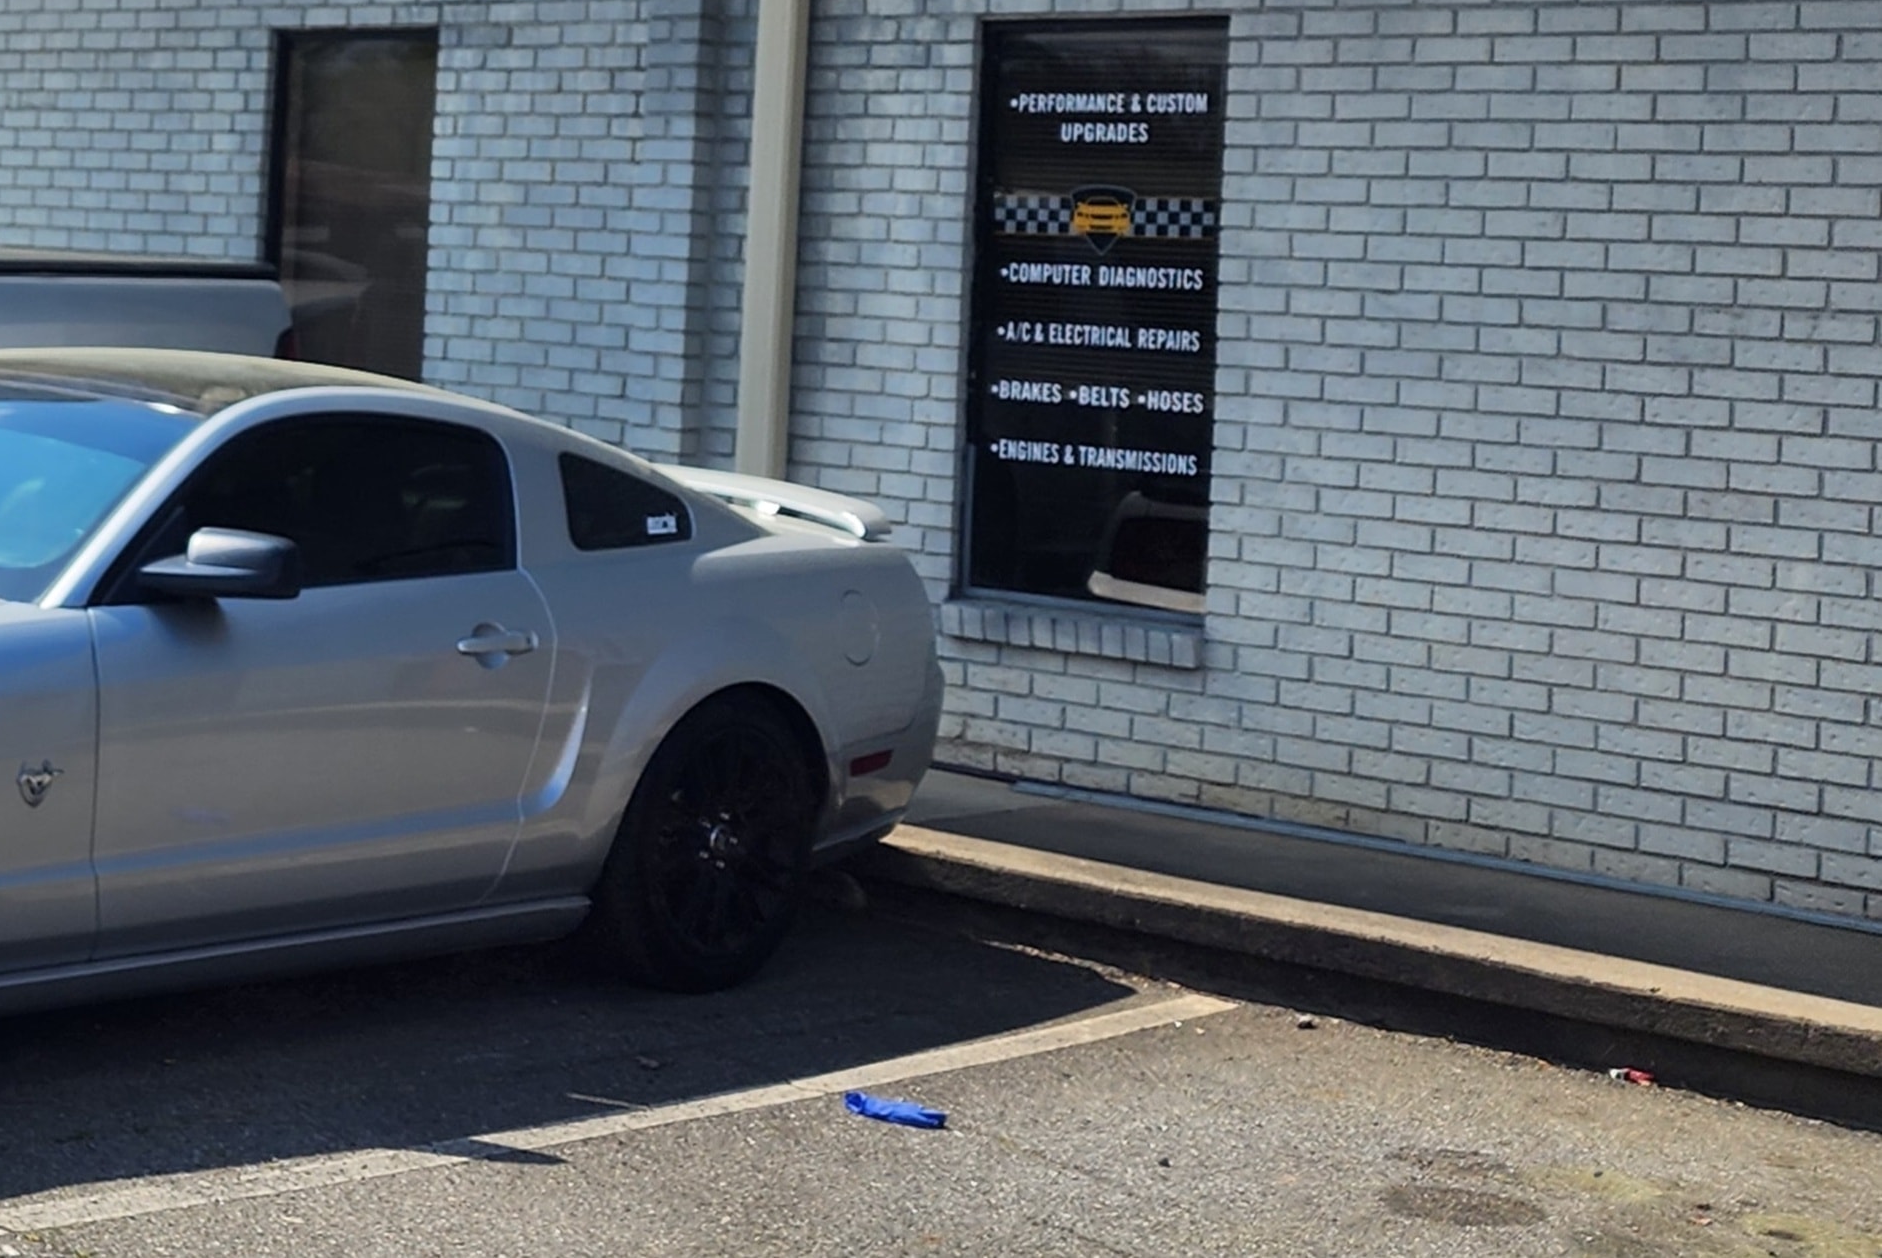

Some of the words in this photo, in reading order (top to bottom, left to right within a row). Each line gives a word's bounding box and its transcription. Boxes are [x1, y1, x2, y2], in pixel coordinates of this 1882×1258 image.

[1018, 93, 1125, 113] PERFORMANCE
[1131, 93, 1142, 113] &
[1146, 93, 1208, 113] CUSTOM
[1060, 122, 1149, 143] UPGRADES
[1009, 262, 1092, 286] COMPUTER
[1098, 265, 1204, 291] DIAGNOSTICS
[1034, 322, 1045, 342] &
[1048, 322, 1132, 348] ELECTRICAL
[1137, 328, 1201, 353] REPAIRS
[998, 379, 1063, 404] BRAKES
[1078, 385, 1131, 409] BELTS
[1147, 390, 1204, 414] HOSES
[998, 438, 1060, 465] ENGINES
[1063, 444, 1075, 466] &
[1078, 445, 1198, 477] TRANSMISSIONS
